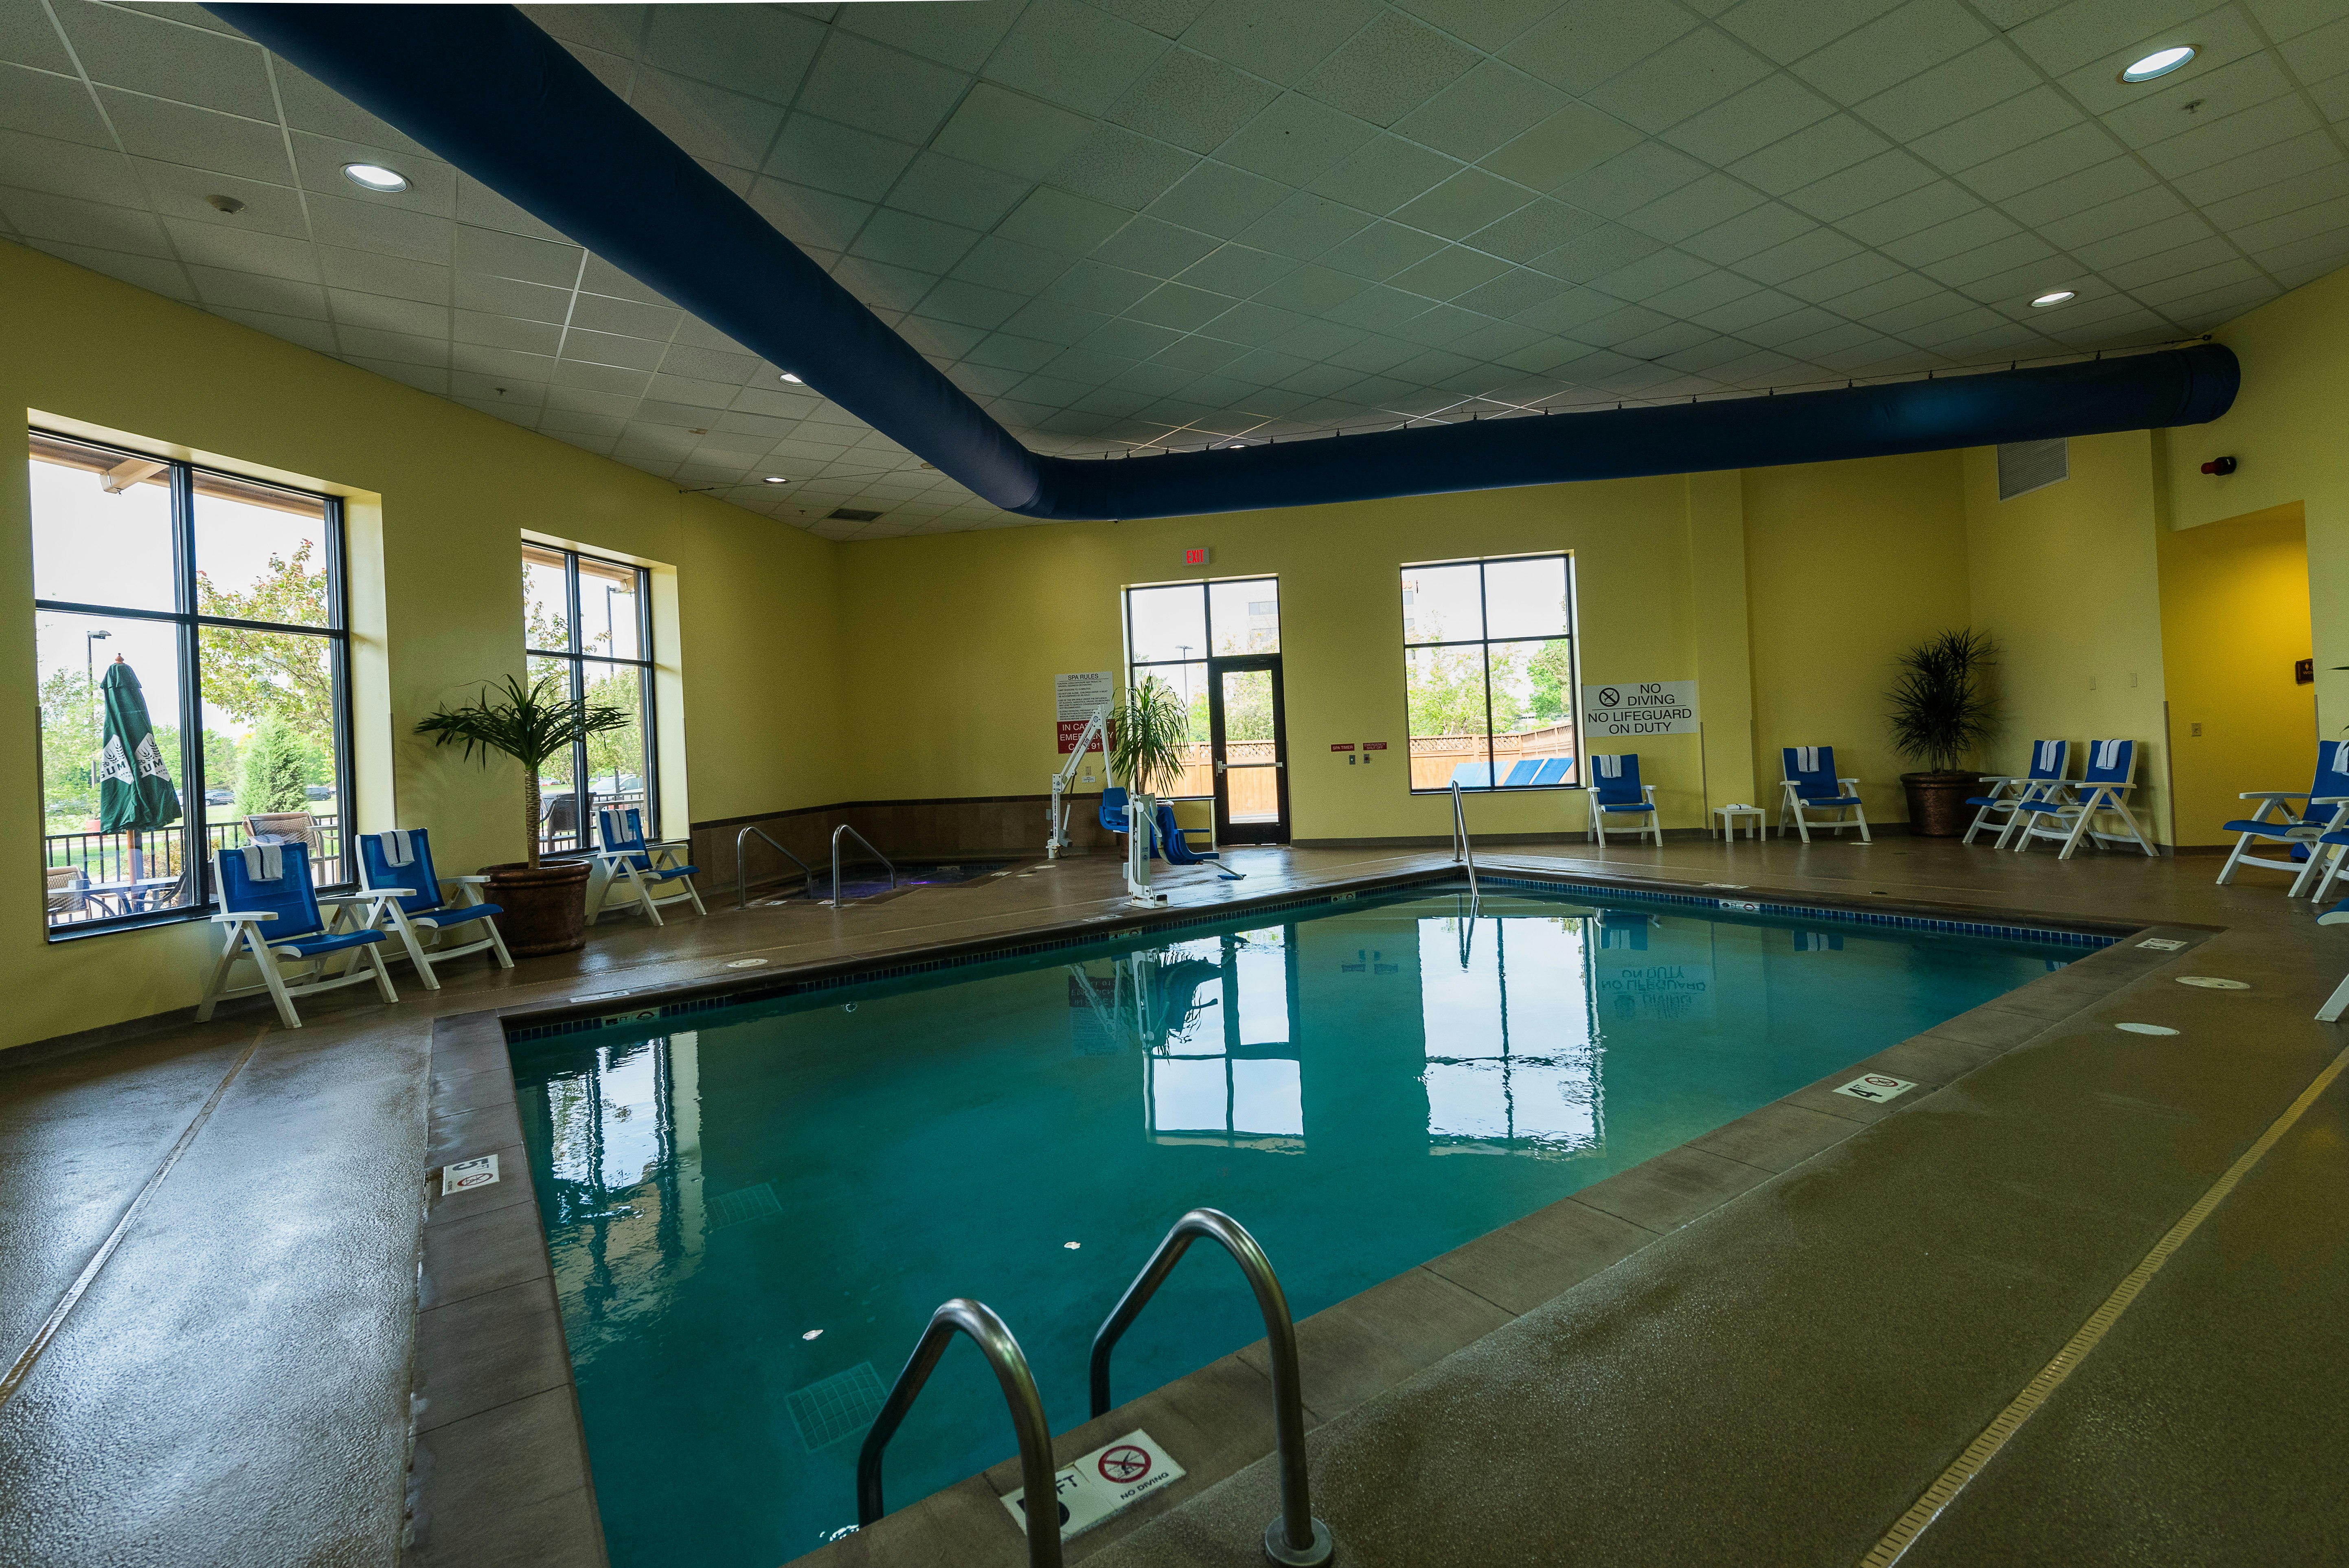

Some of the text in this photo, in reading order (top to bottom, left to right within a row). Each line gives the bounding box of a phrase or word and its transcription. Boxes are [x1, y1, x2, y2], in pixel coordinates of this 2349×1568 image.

[1187, 549, 1204, 564] EXIT
[1641, 684, 1661, 694] NO
[1628, 694, 1675, 706] DIVING
[1588, 708, 1691, 723] NO LIFEGUARD
[1609, 722, 1671, 734] ON DUTY
[1847, 1088, 1883, 1098] 4
[452, 1158, 489, 1171] 5
[1120, 1472, 1169, 1500] NO DIVING
